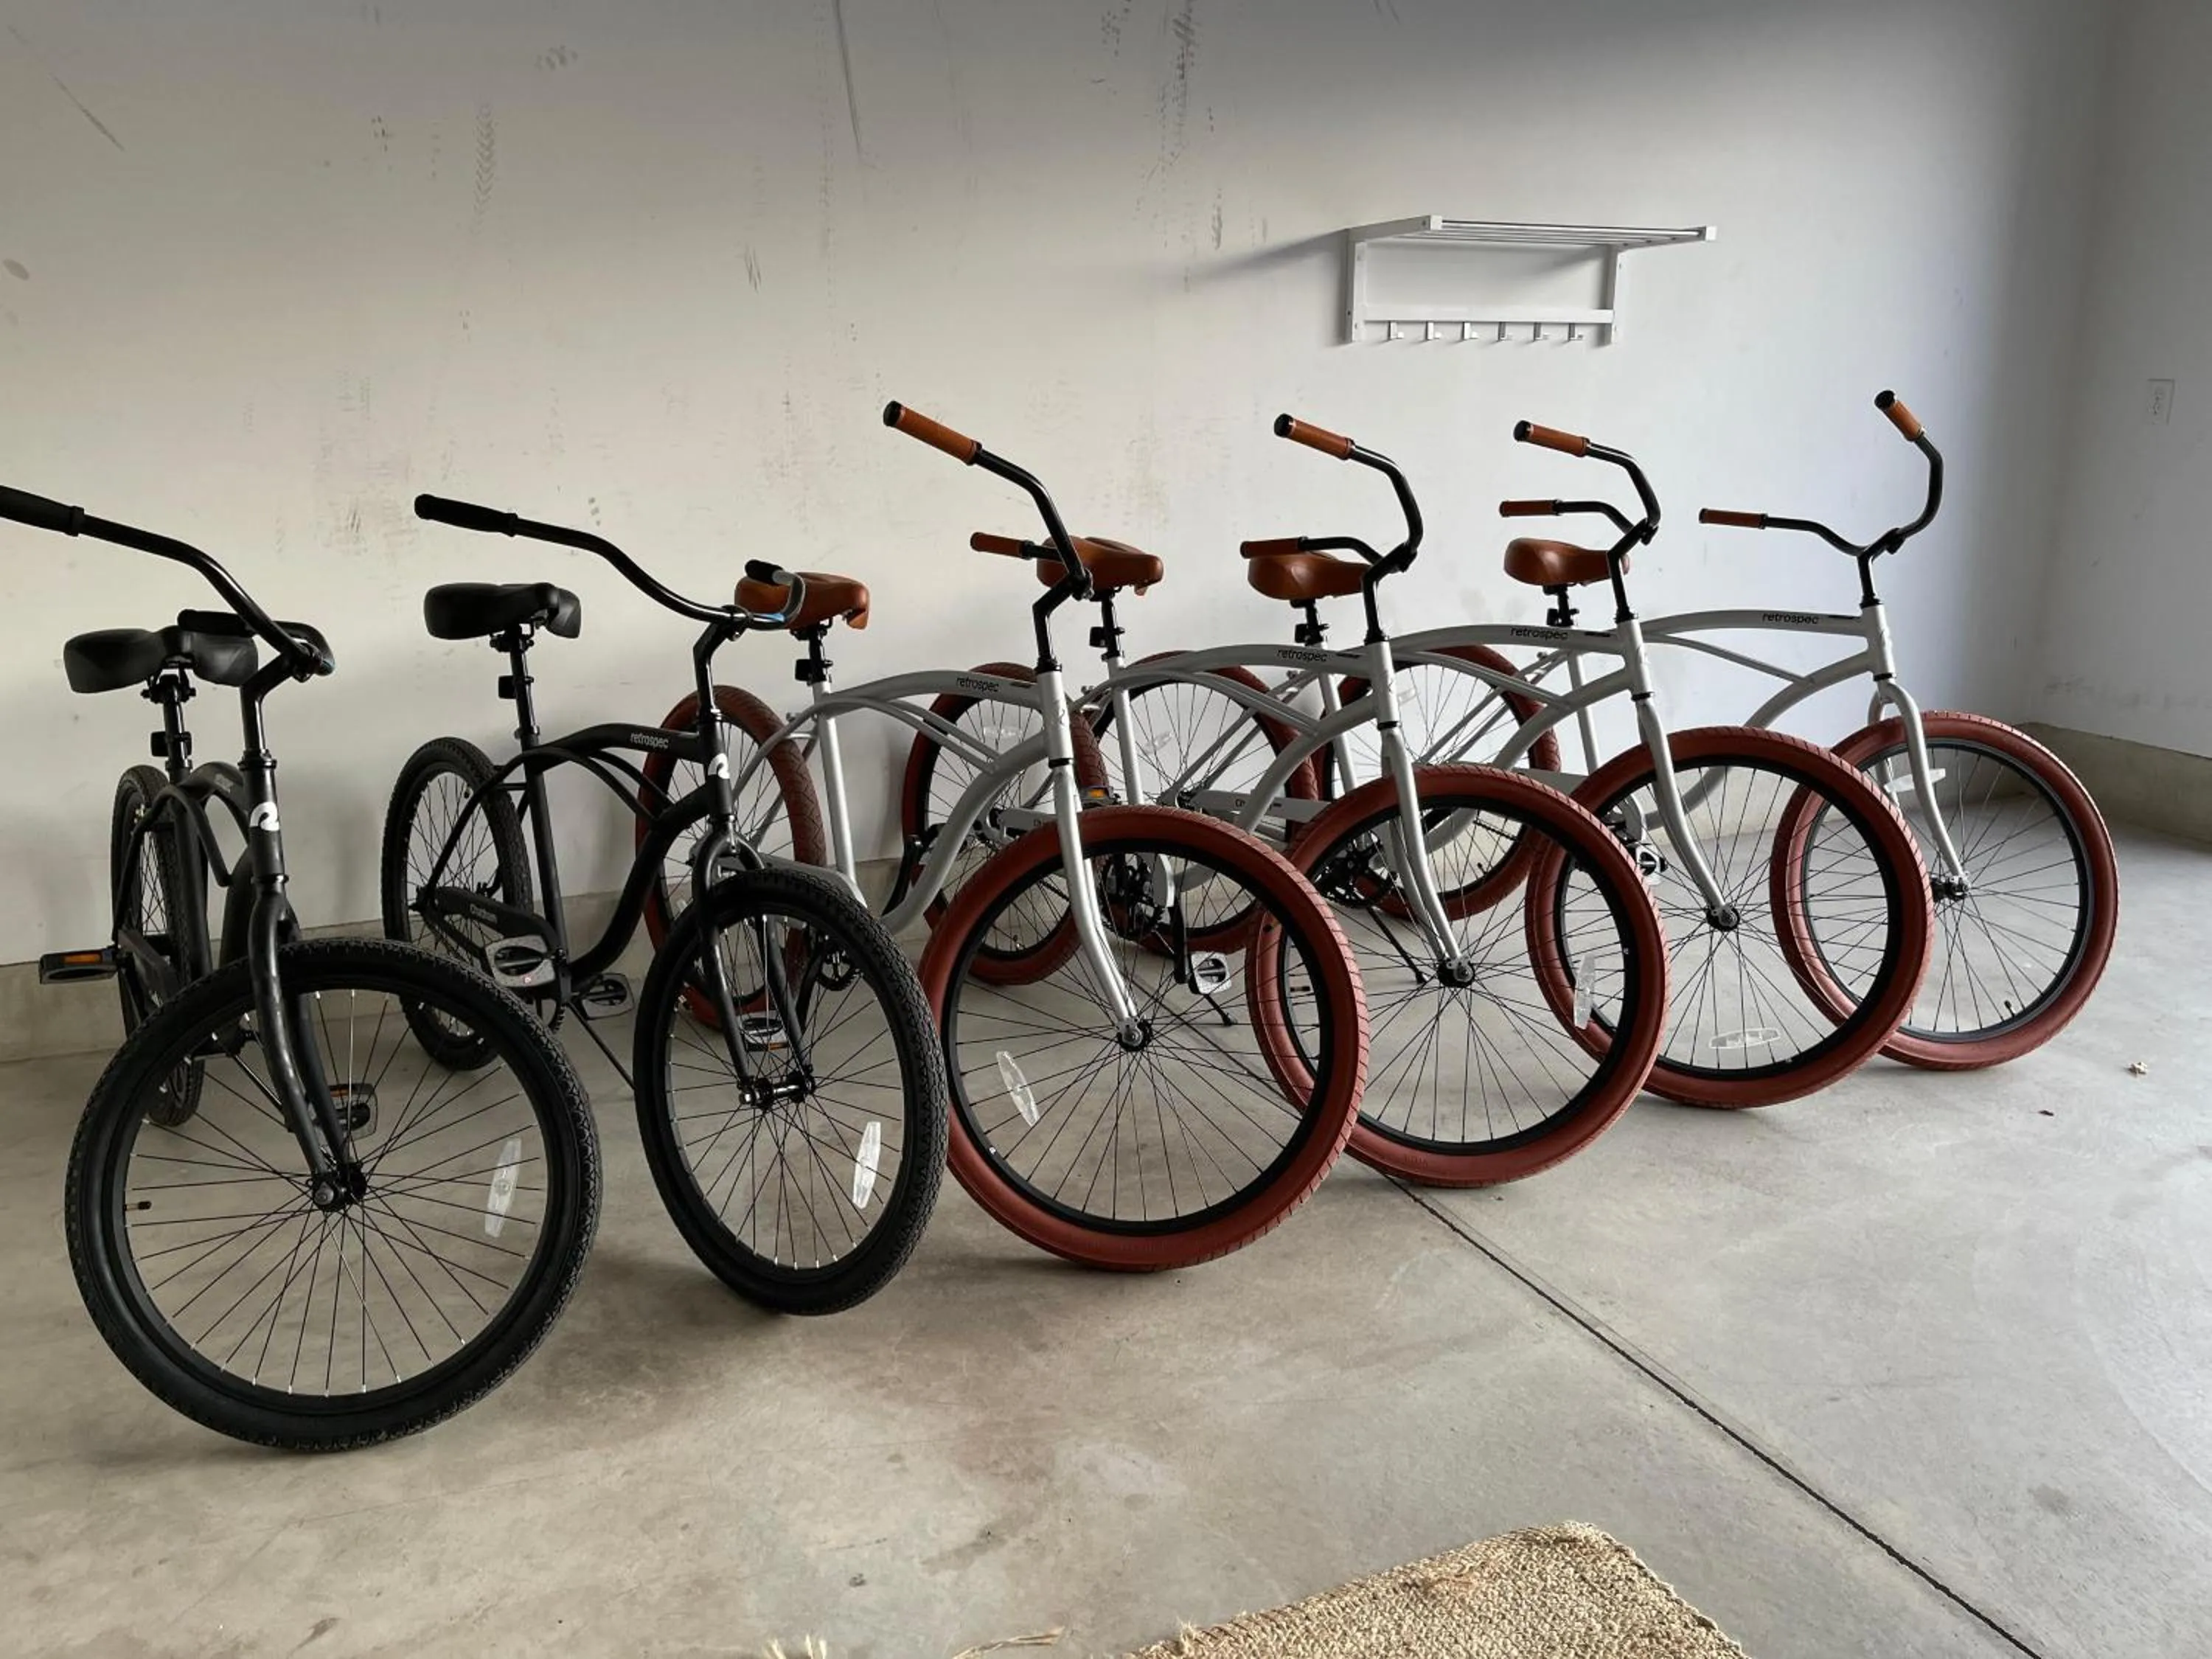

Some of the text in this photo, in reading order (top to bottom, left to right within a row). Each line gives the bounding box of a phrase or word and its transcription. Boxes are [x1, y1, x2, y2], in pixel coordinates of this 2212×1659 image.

[1762, 613, 1820, 625] retrospec
[1510, 627, 1569, 640] retrospec
[1276, 649, 1327, 662] retrospec
[956, 676, 1000, 692] retrospec
[630, 732, 669, 749] retrospec
